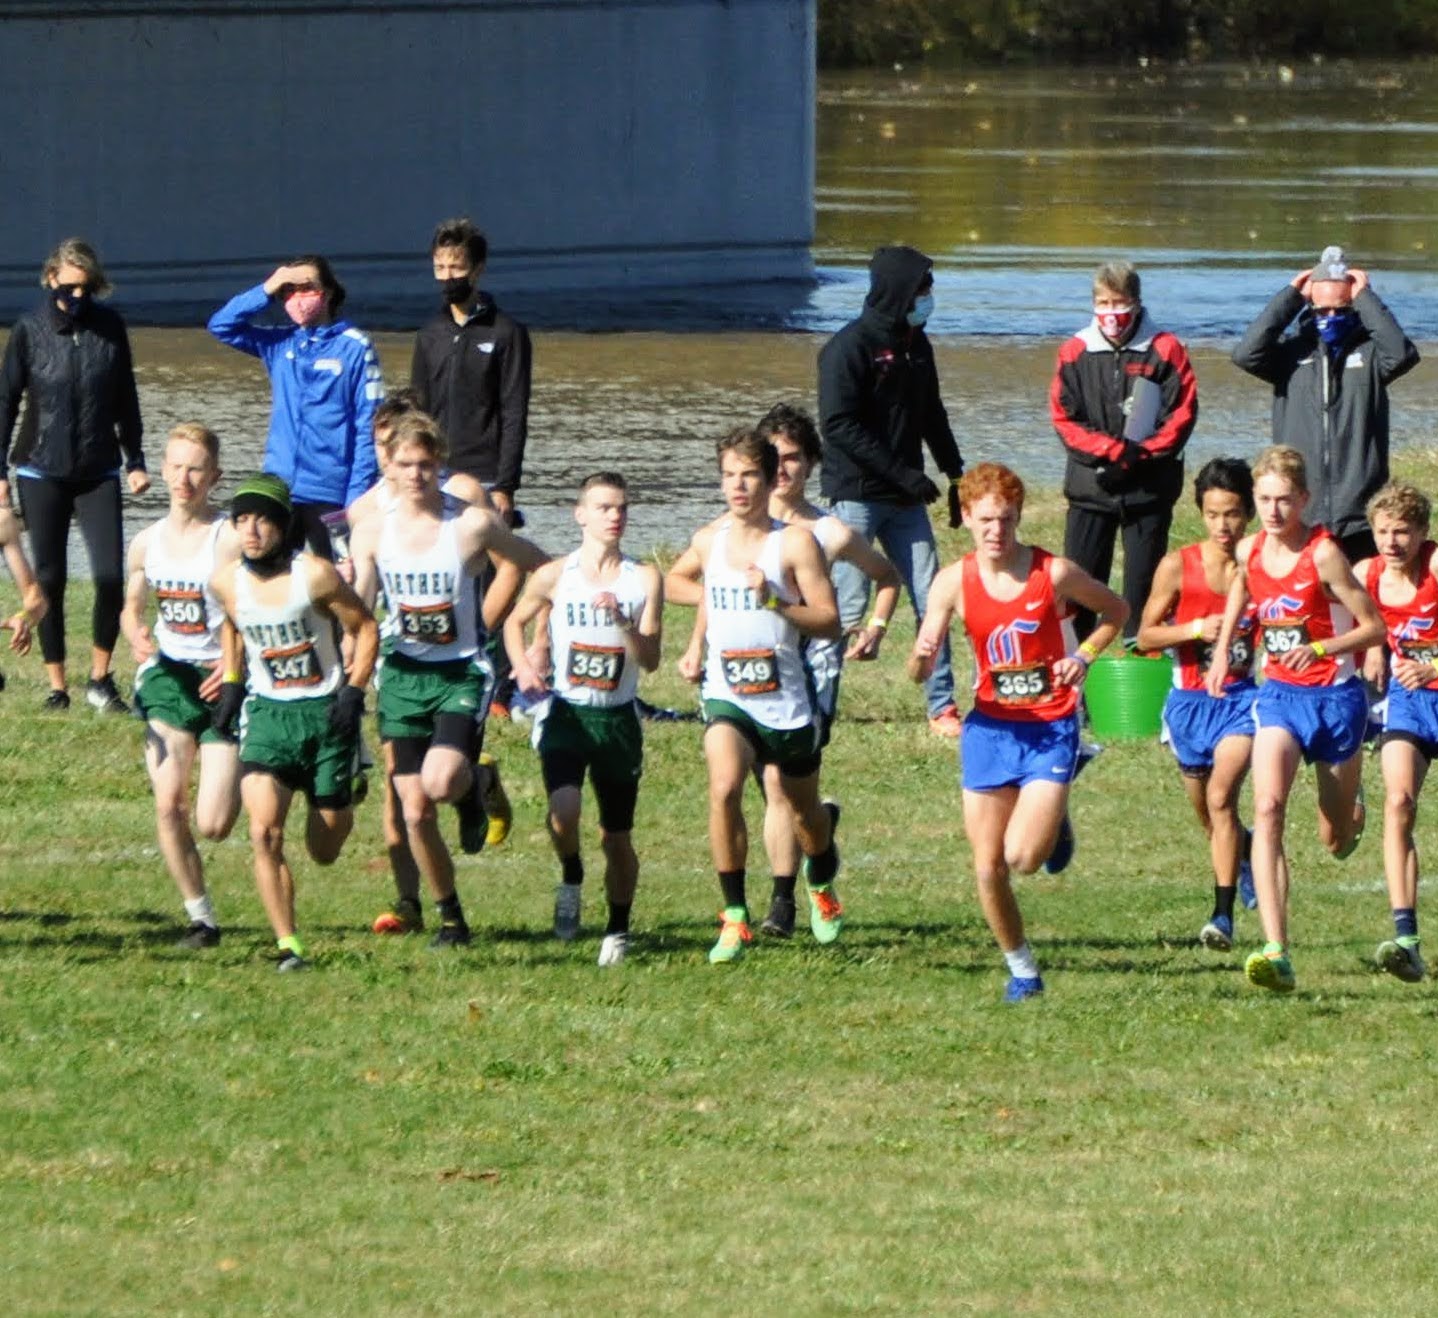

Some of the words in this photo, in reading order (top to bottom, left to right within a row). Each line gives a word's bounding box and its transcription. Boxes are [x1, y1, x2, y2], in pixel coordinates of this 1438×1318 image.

[161, 599, 200, 623] 350
[404, 613, 450, 634] 353
[1264, 630, 1302, 653] 362
[270, 653, 311, 679] 347
[573, 652, 618, 679] 351
[726, 659, 772, 684] 349
[998, 671, 1044, 695] 365
